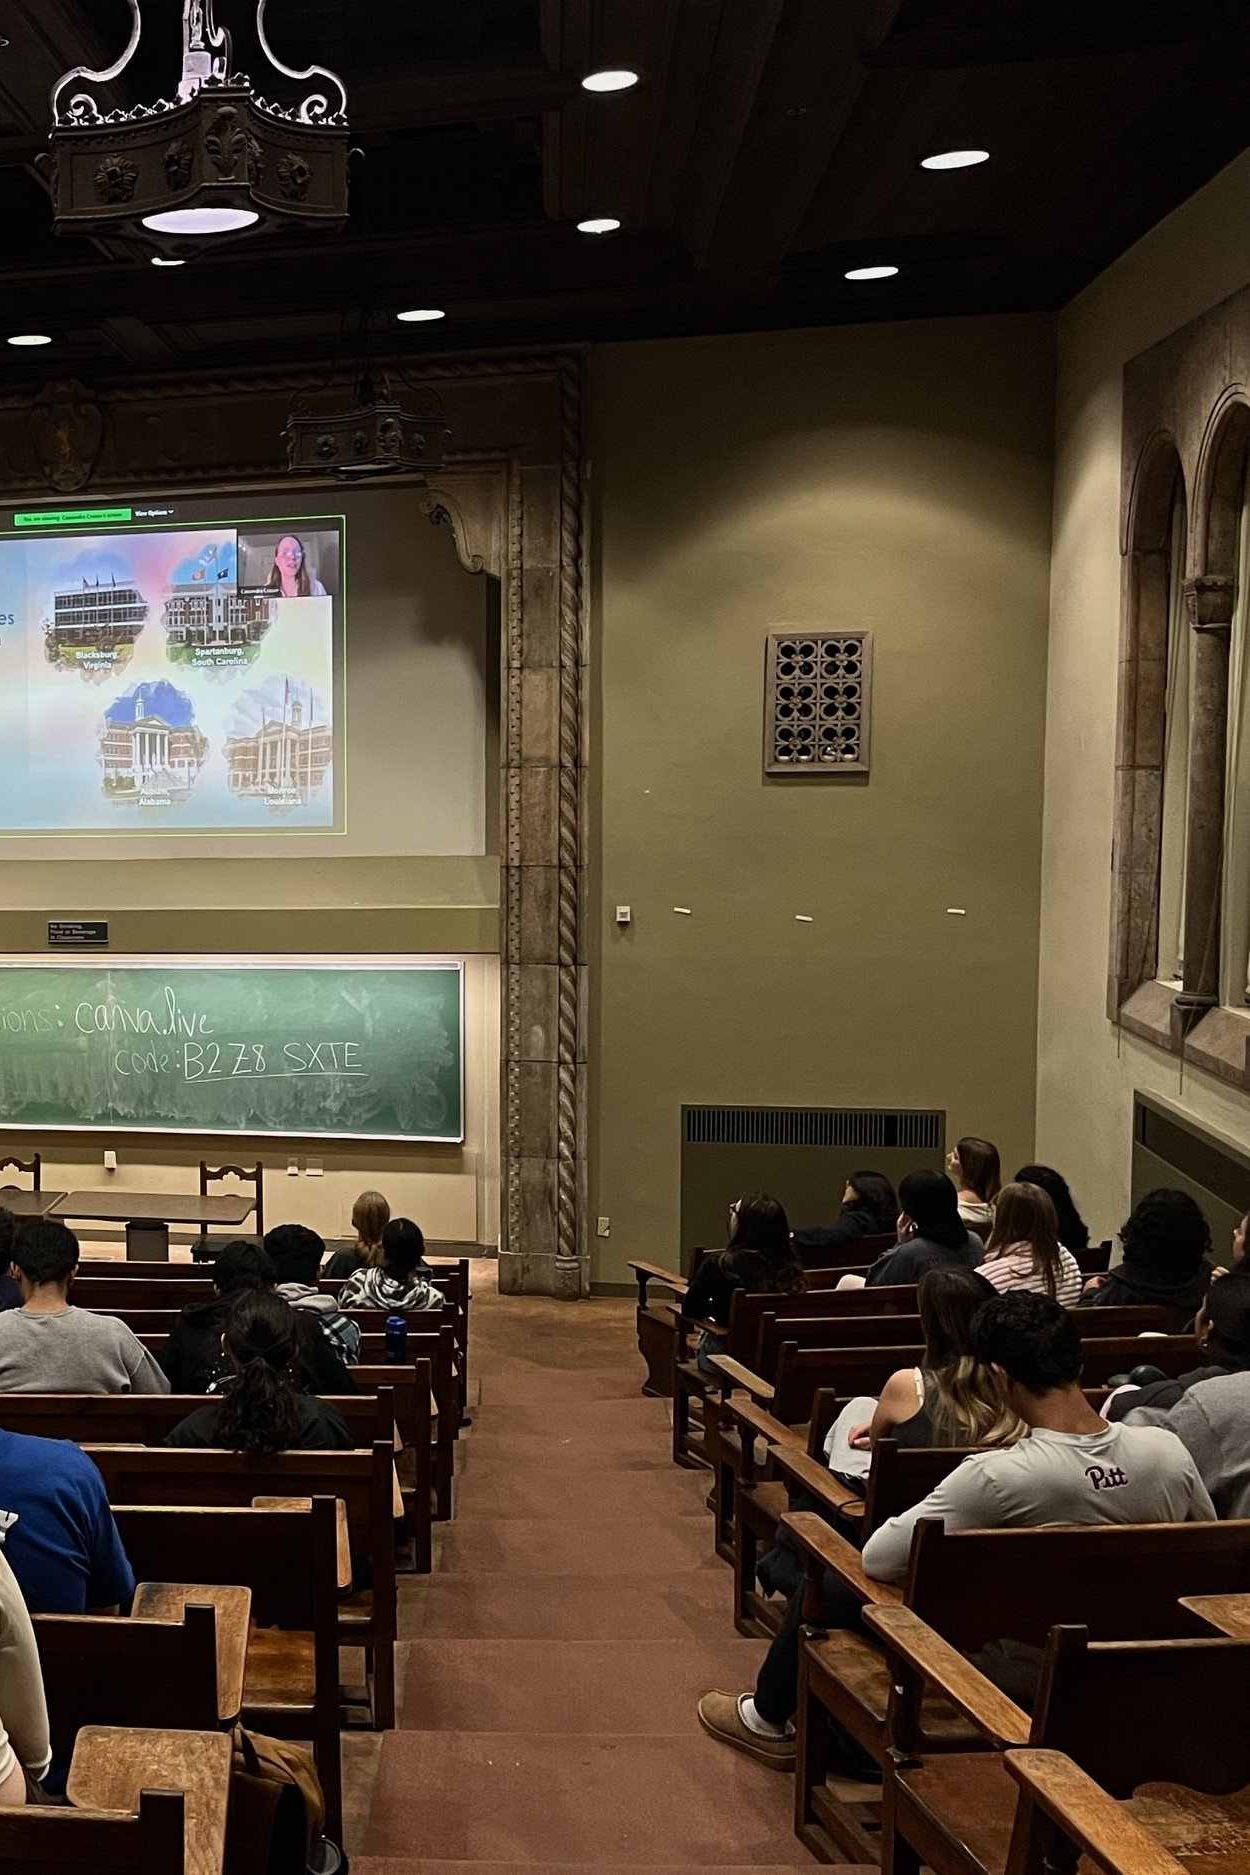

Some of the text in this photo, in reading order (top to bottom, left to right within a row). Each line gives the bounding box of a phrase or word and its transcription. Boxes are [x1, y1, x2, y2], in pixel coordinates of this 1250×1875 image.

[194, 647, 244, 657] Spartanburg,
[83, 660, 112, 671] Virginia
[191, 657, 248, 667] South Carolina
[138, 798, 172, 806] Alabama
[264, 796, 302, 806] Louisiana
[74, 985, 214, 1037] canva.live
[283, 1042, 362, 1073] SXTE
[1084, 1465, 1129, 1491] Pitt
